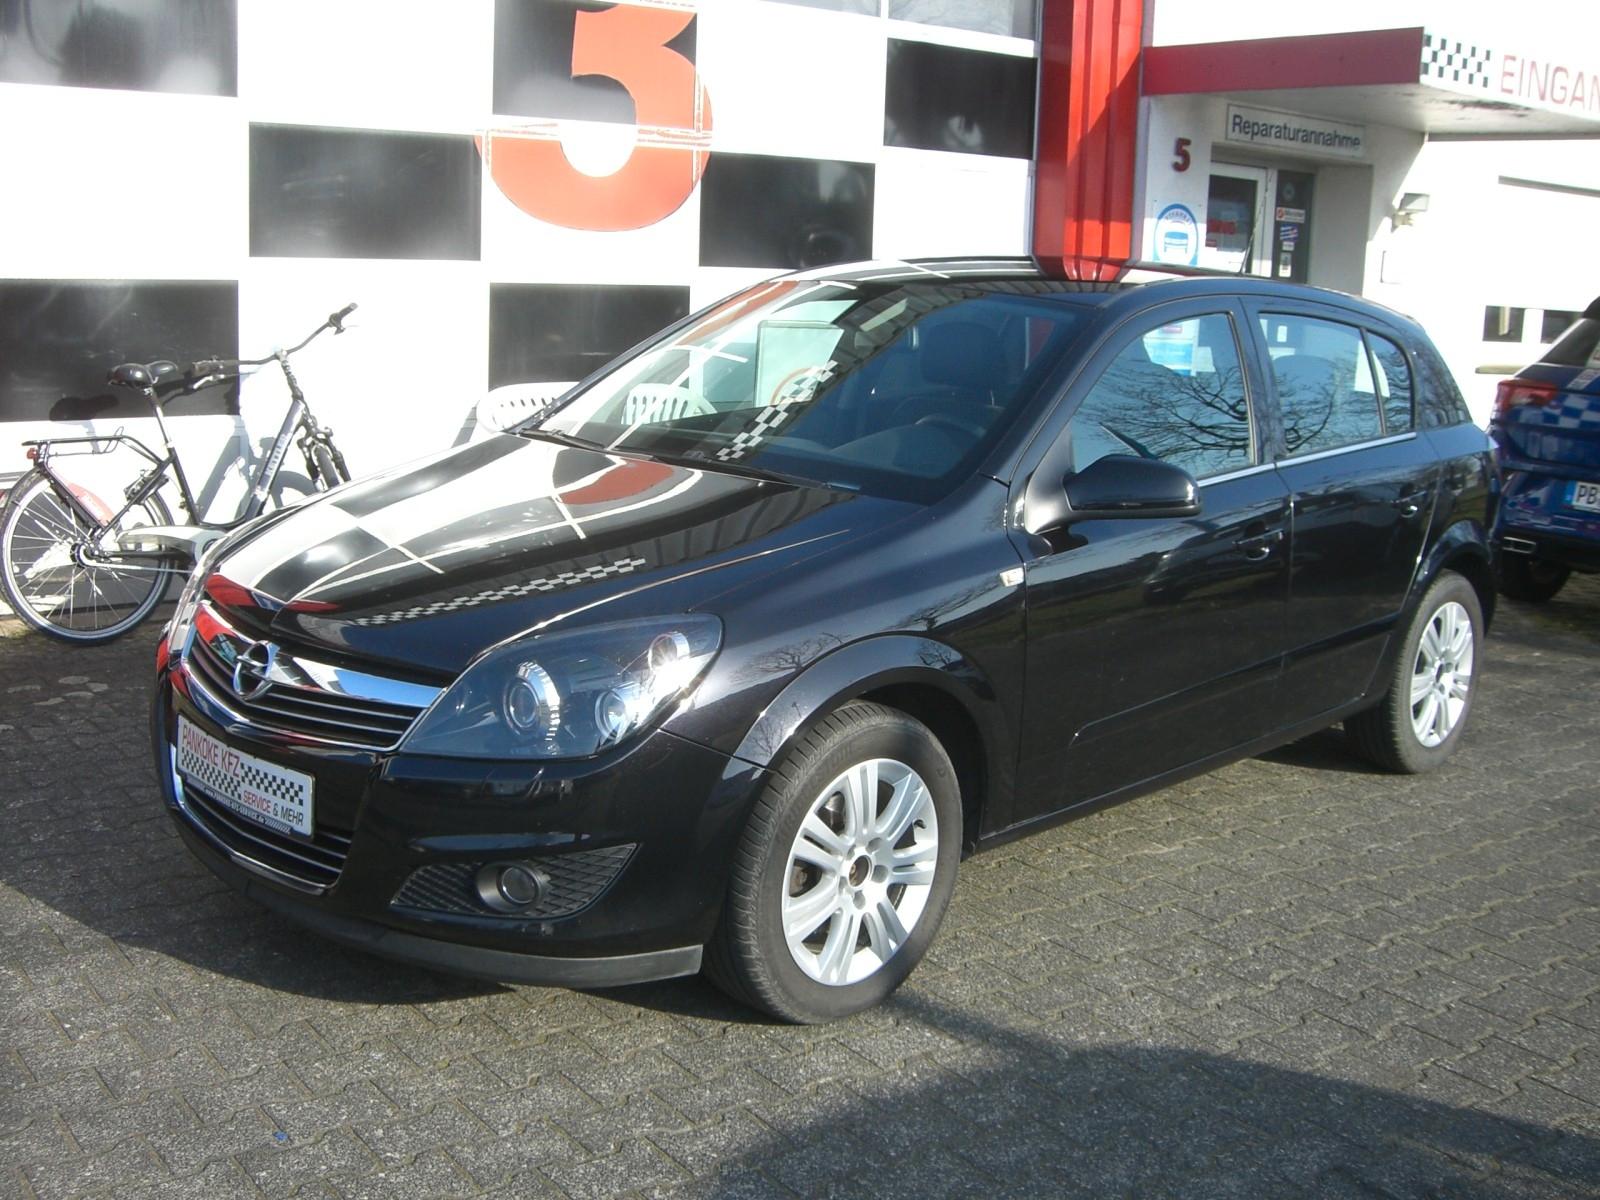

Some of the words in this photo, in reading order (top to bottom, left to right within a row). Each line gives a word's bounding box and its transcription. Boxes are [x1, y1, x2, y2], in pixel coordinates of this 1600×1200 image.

[473, 3, 713, 232] 3
[1232, 114, 1361, 150] Reparaturannahme
[1172, 137, 1192, 172] 5
[1576, 484, 1597, 505] PB
[183, 724, 218, 765] PANKOKE
[221, 750, 240, 778] KFZ
[243, 789, 271, 813] SERVICE
[273, 802, 279, 817] &
[281, 806, 304, 826] MEHR
